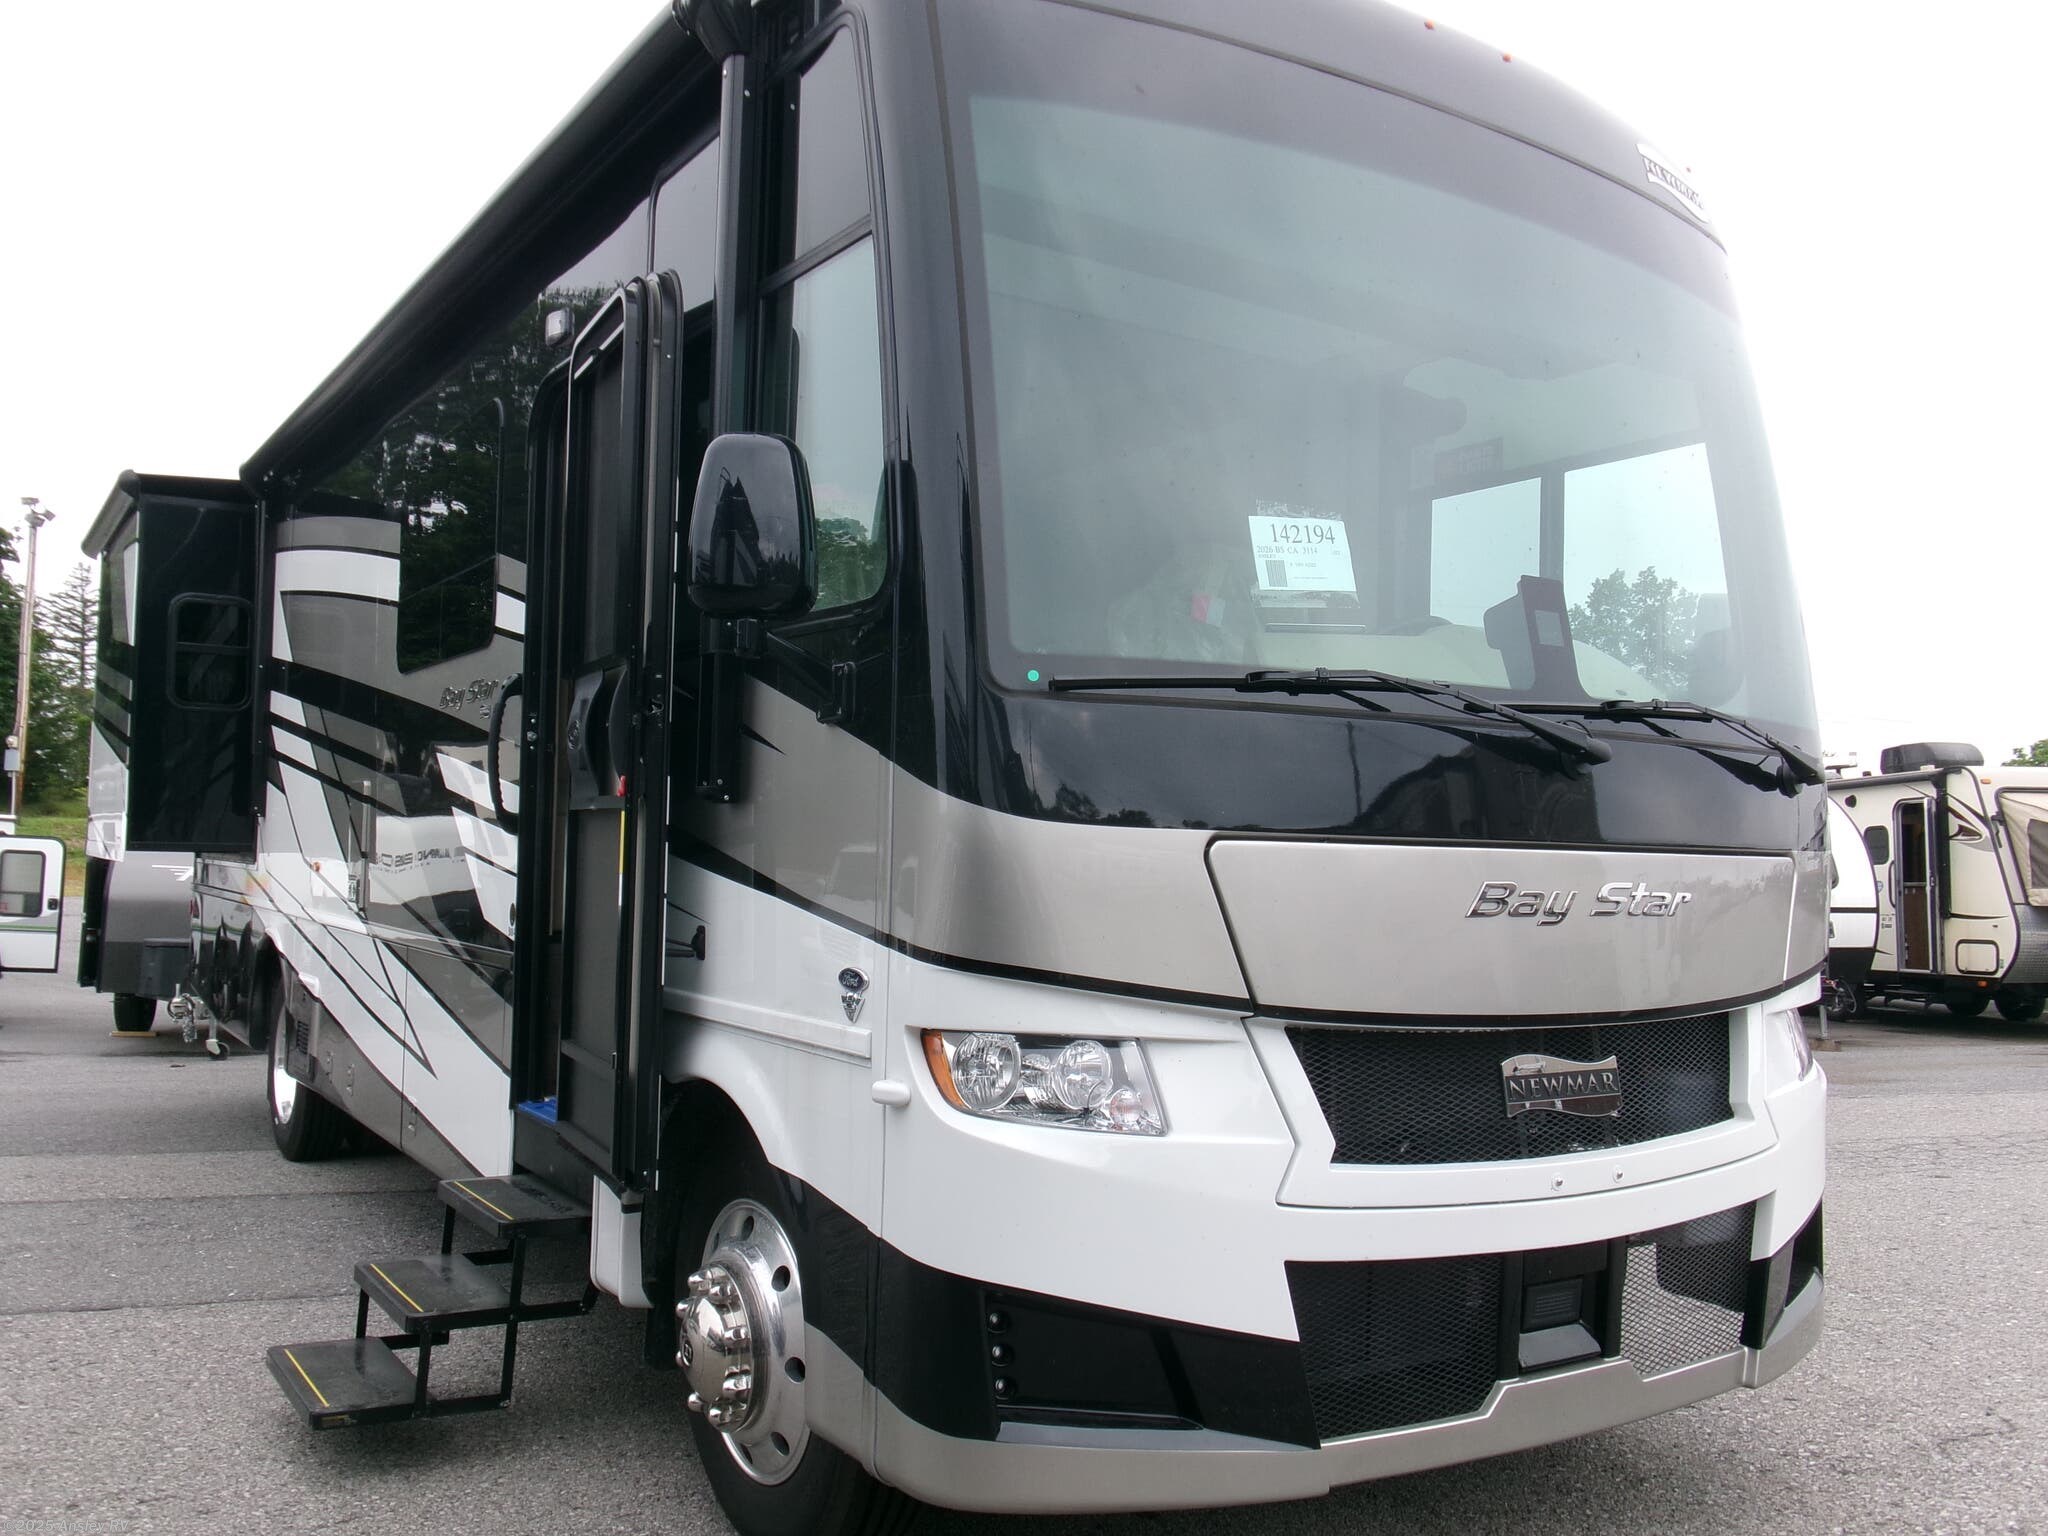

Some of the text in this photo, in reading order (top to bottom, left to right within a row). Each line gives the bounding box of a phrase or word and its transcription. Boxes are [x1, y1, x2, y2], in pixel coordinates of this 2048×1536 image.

[1270, 523, 1336, 544] 142194
[1256, 545, 1274, 554] 2026
[440, 679, 499, 711] Bay Star
[1465, 881, 1692, 926] Bay Star
[1509, 1072, 1618, 1098] NEWMAR
